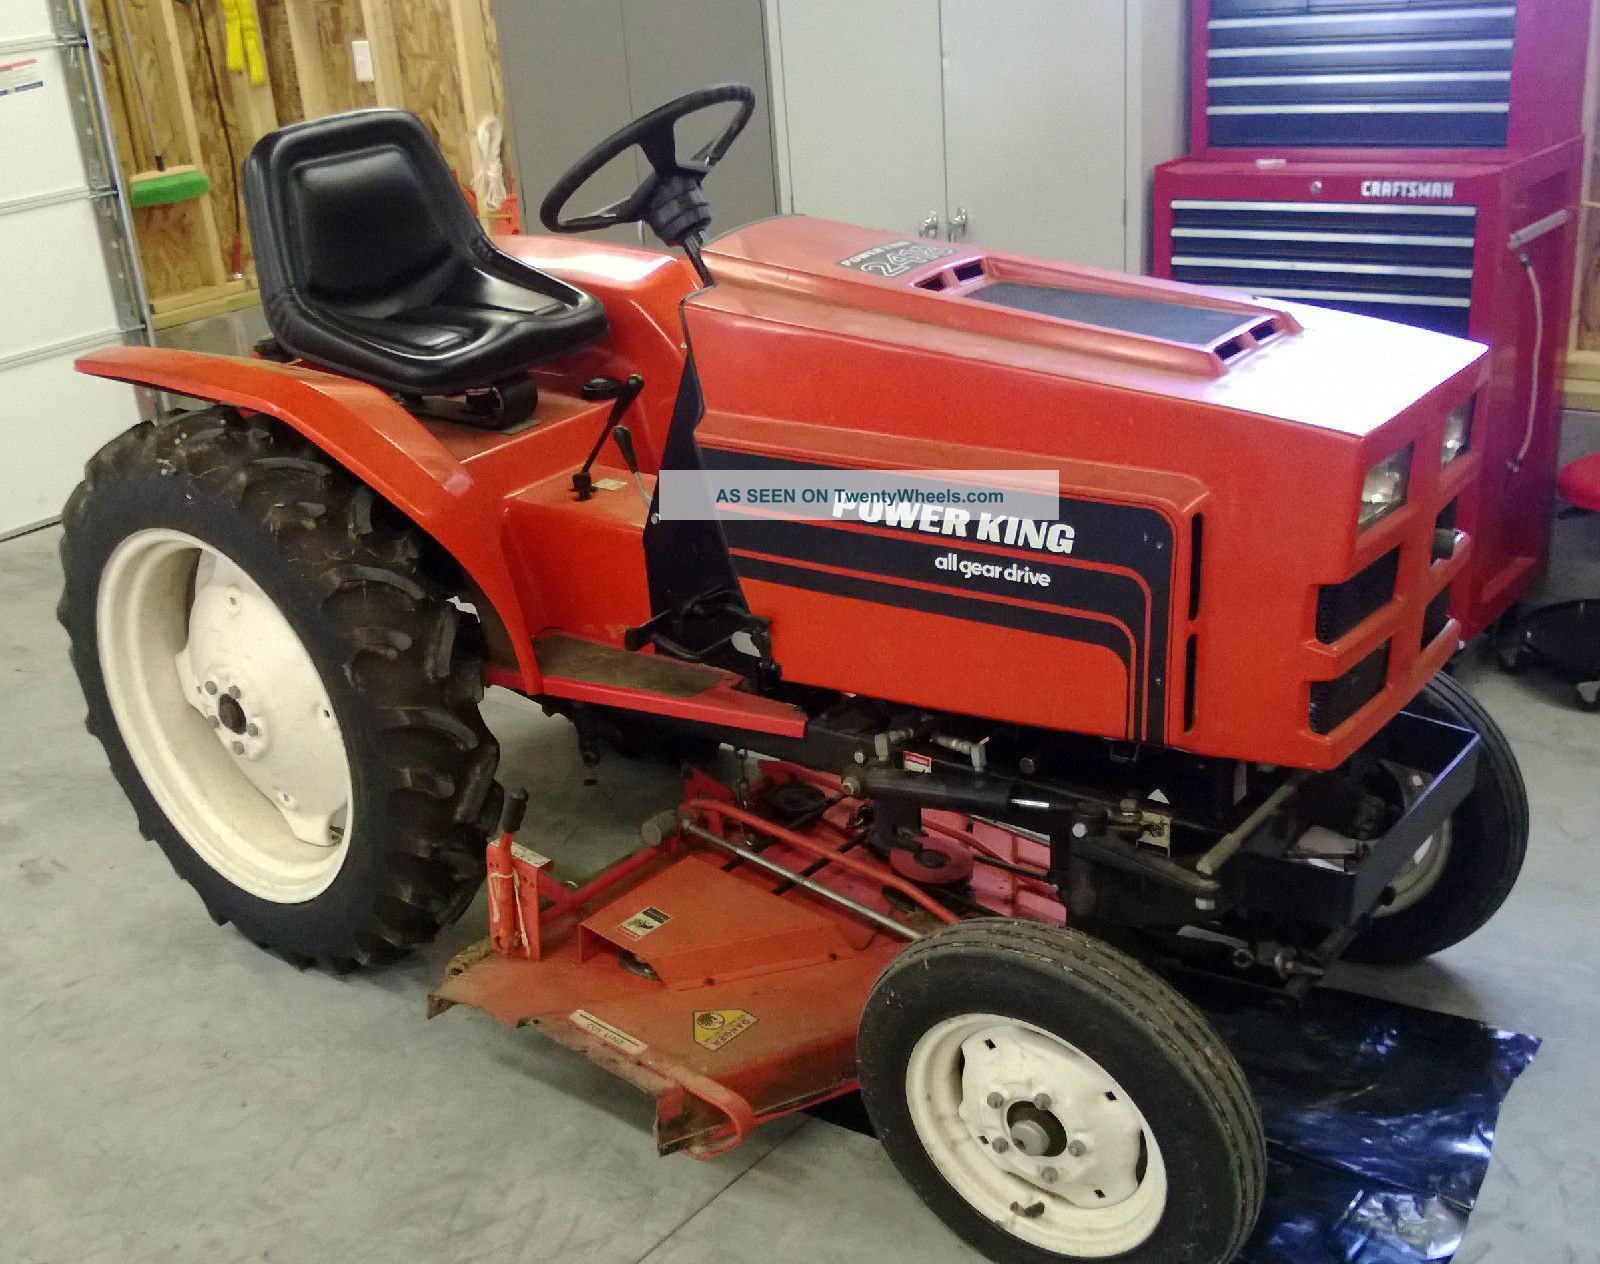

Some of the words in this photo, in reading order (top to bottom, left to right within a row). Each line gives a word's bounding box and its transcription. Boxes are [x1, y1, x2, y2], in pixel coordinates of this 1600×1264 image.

[1361, 180, 1454, 198] CRAFTSMAN
[831, 492, 971, 538] POWER
[976, 512, 1076, 554] KING
[934, 553, 958, 572] all
[959, 559, 1003, 578] gear
[1003, 563, 1051, 587] drive
